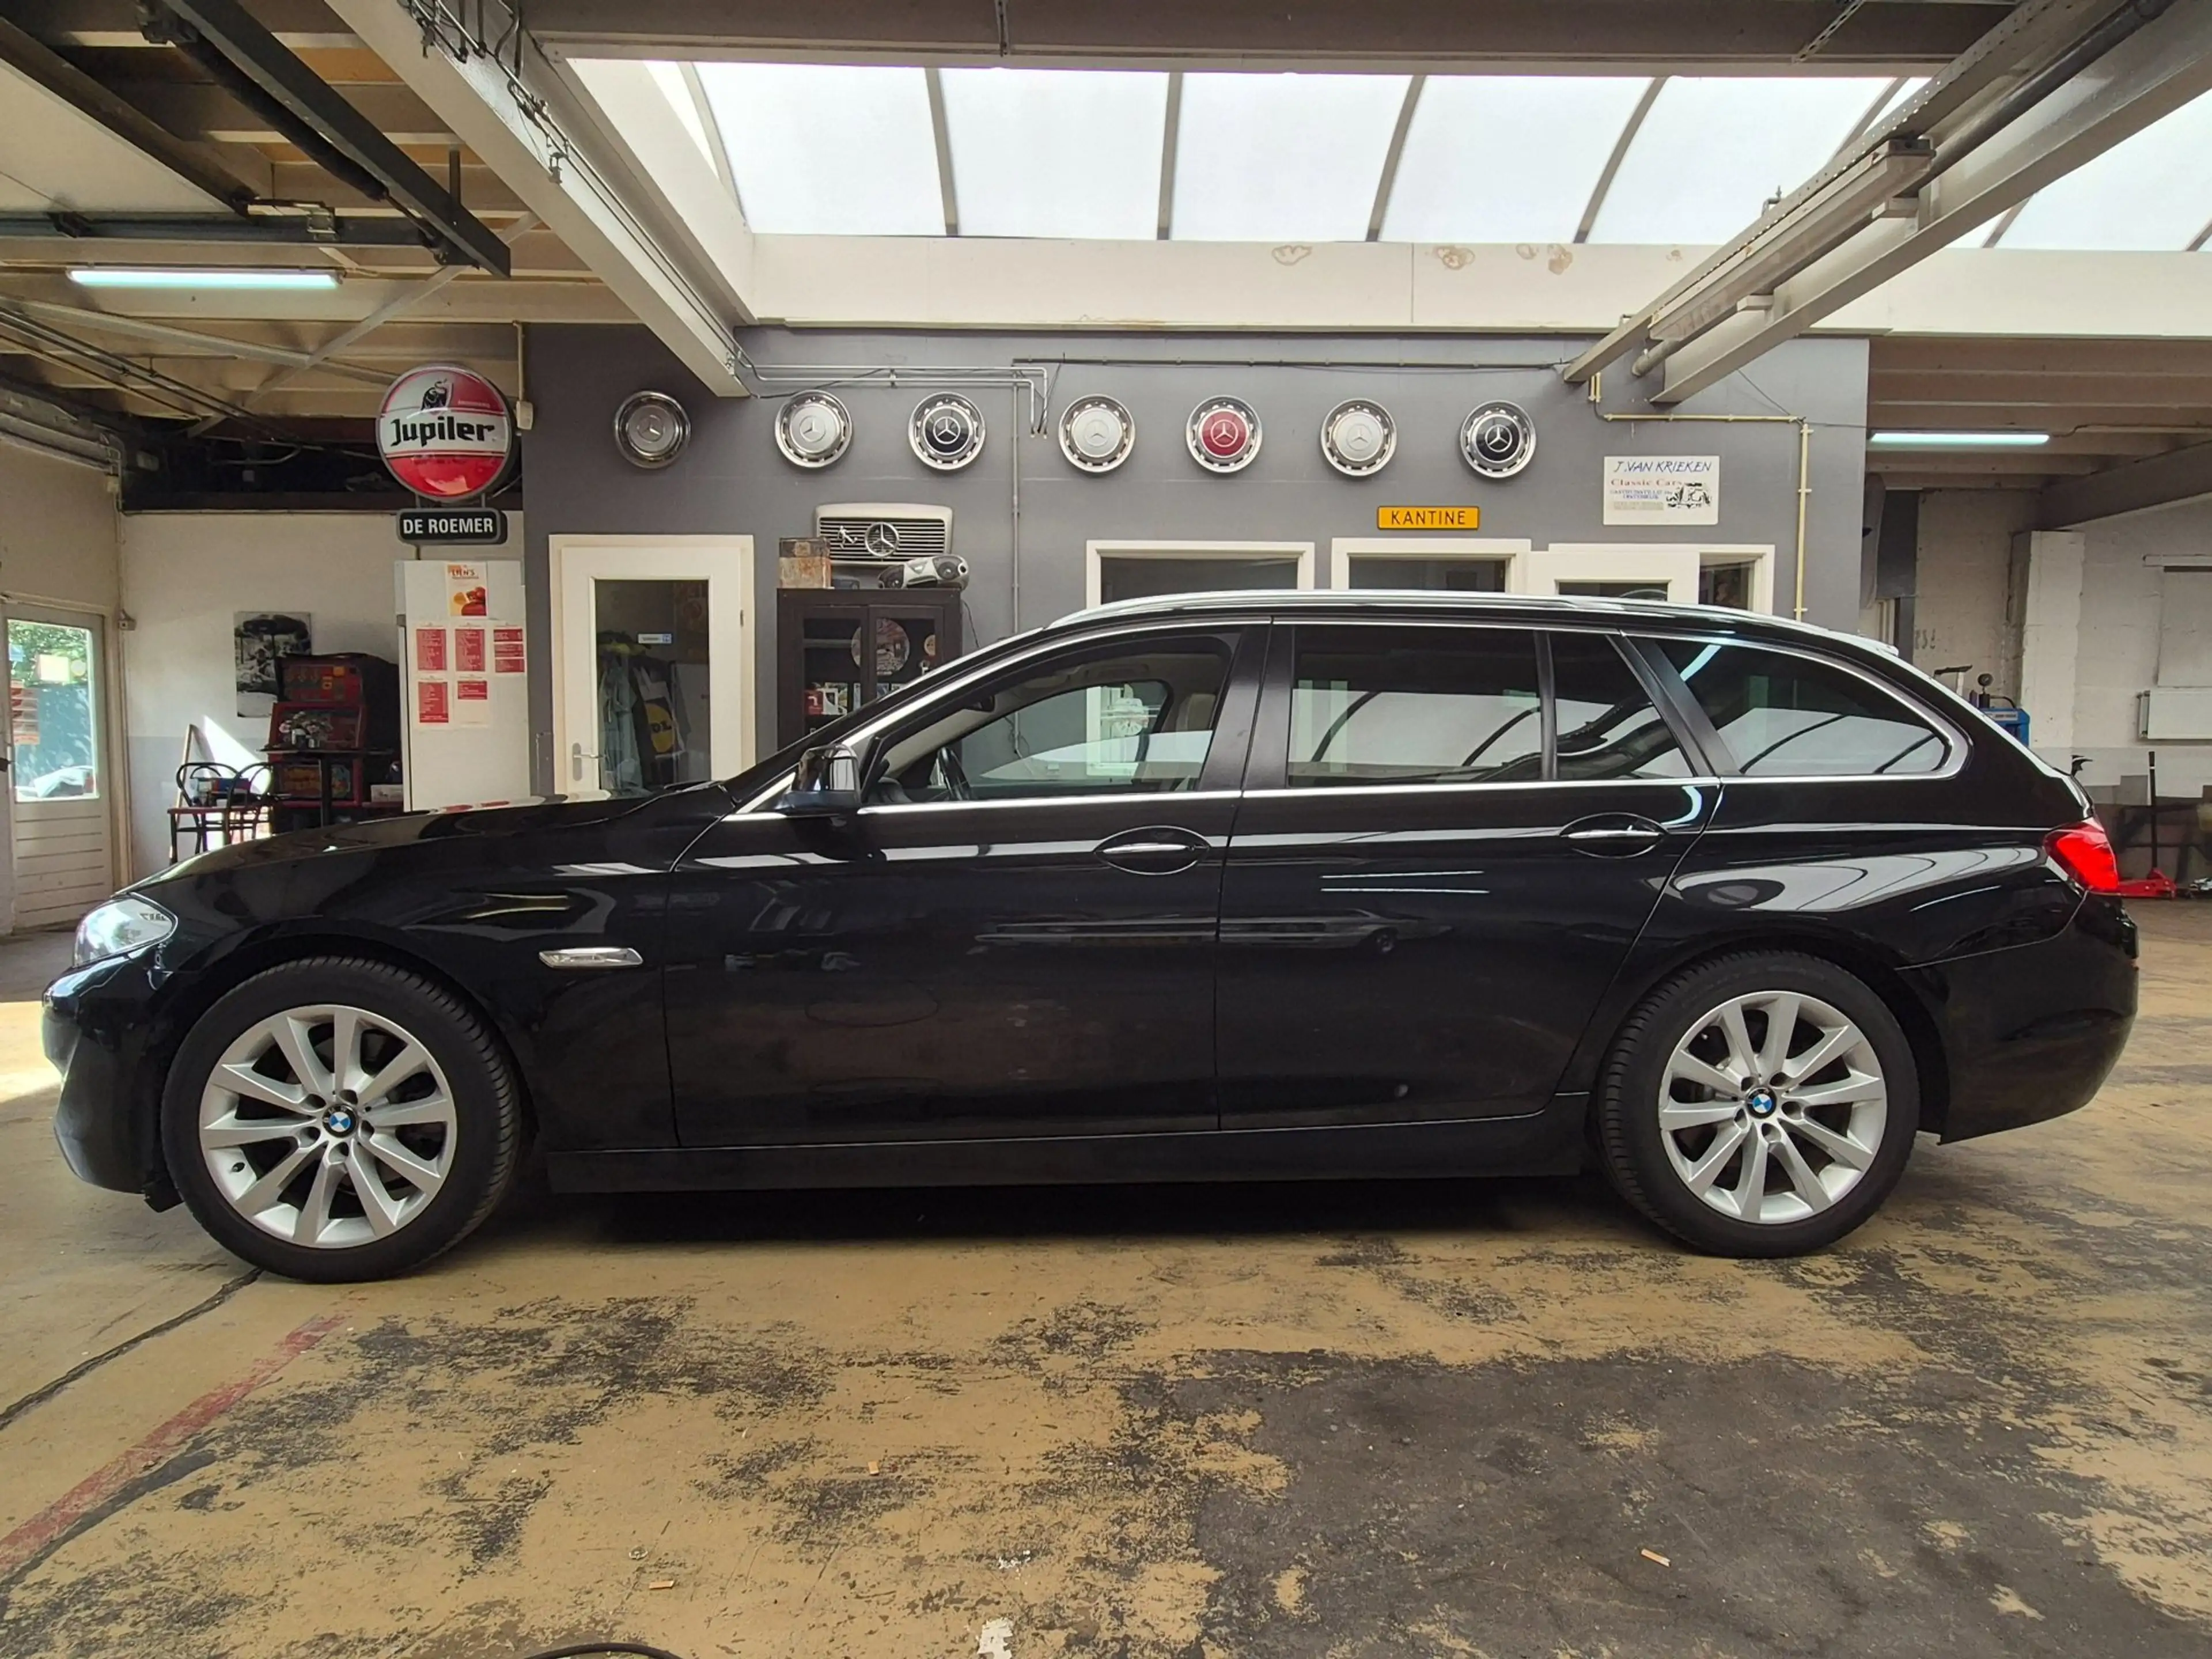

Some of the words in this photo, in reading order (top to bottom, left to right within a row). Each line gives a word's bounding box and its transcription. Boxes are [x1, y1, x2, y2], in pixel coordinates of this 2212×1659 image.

[390, 416, 495, 447] Jupiler
[1656, 460, 1712, 474] KRIEKEN
[1611, 478, 1653, 486] Classic
[1656, 478, 1683, 486] Cars
[1391, 510, 1466, 525] KANTINE
[403, 518, 423, 535] DE
[428, 517, 494, 534] ROEMER
